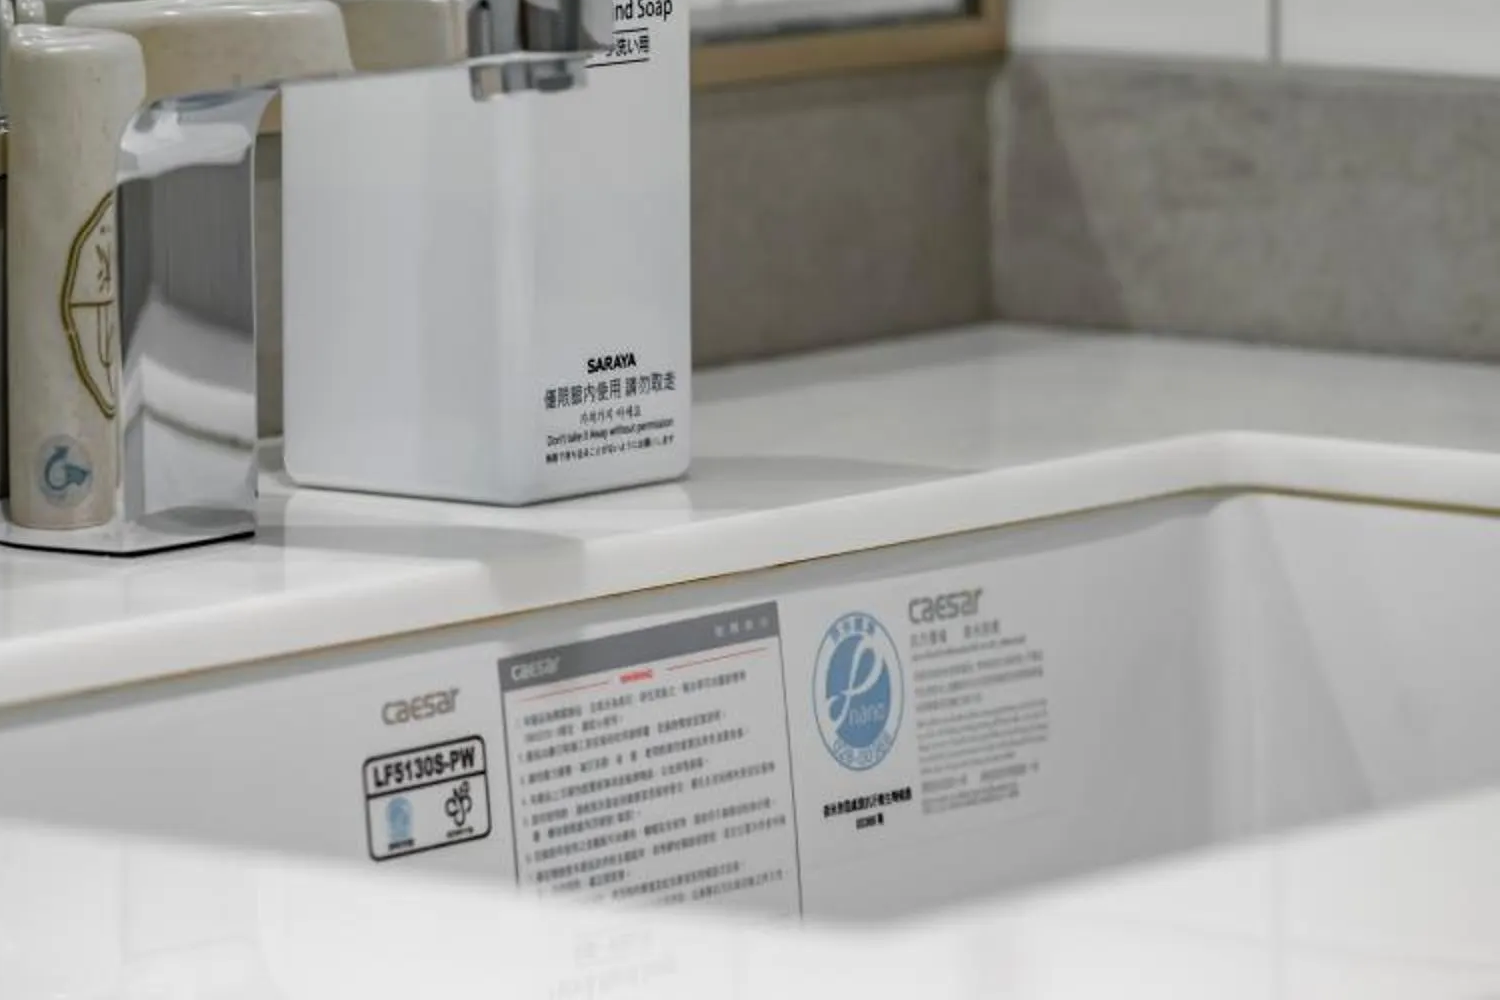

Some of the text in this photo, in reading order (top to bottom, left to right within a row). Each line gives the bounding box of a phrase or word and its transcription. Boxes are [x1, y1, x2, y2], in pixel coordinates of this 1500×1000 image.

[587, 352, 637, 374] SARAYA
[908, 587, 984, 625] caesar
[381, 687, 460, 726] caesar
[372, 745, 476, 788] LF5130S-PW
